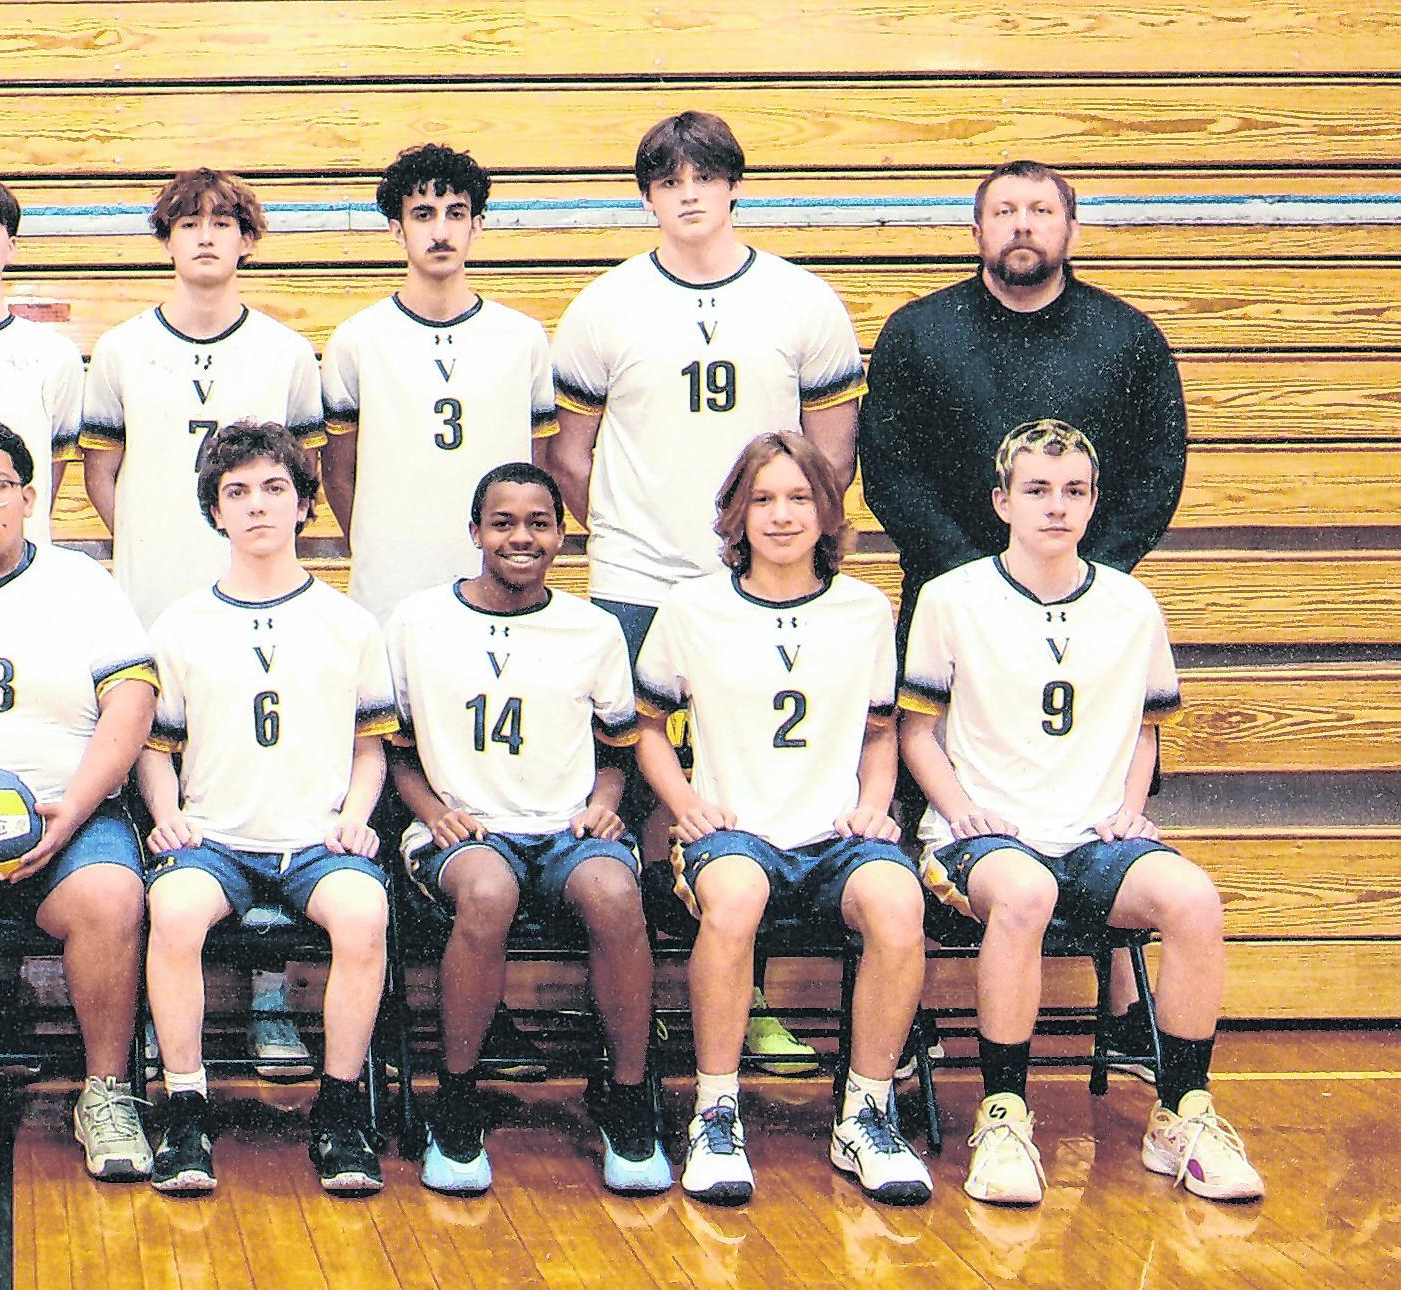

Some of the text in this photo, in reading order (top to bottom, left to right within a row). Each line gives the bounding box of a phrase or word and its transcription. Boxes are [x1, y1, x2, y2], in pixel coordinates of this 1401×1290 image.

[697, 321, 717, 345] V
[434, 359, 456, 383] V
[681, 360, 736, 412] 19
[192, 380, 214, 405] V
[434, 398, 463, 450] 3
[189, 420, 218, 473] 7
[253, 645, 275, 674] V
[487, 651, 510, 679] V
[775, 645, 801, 673] V
[1046, 638, 1070, 664] V
[254, 691, 279, 747] 6
[466, 694, 523, 755] 14
[773, 690, 806, 748] 2
[1042, 681, 1074, 736] 9
